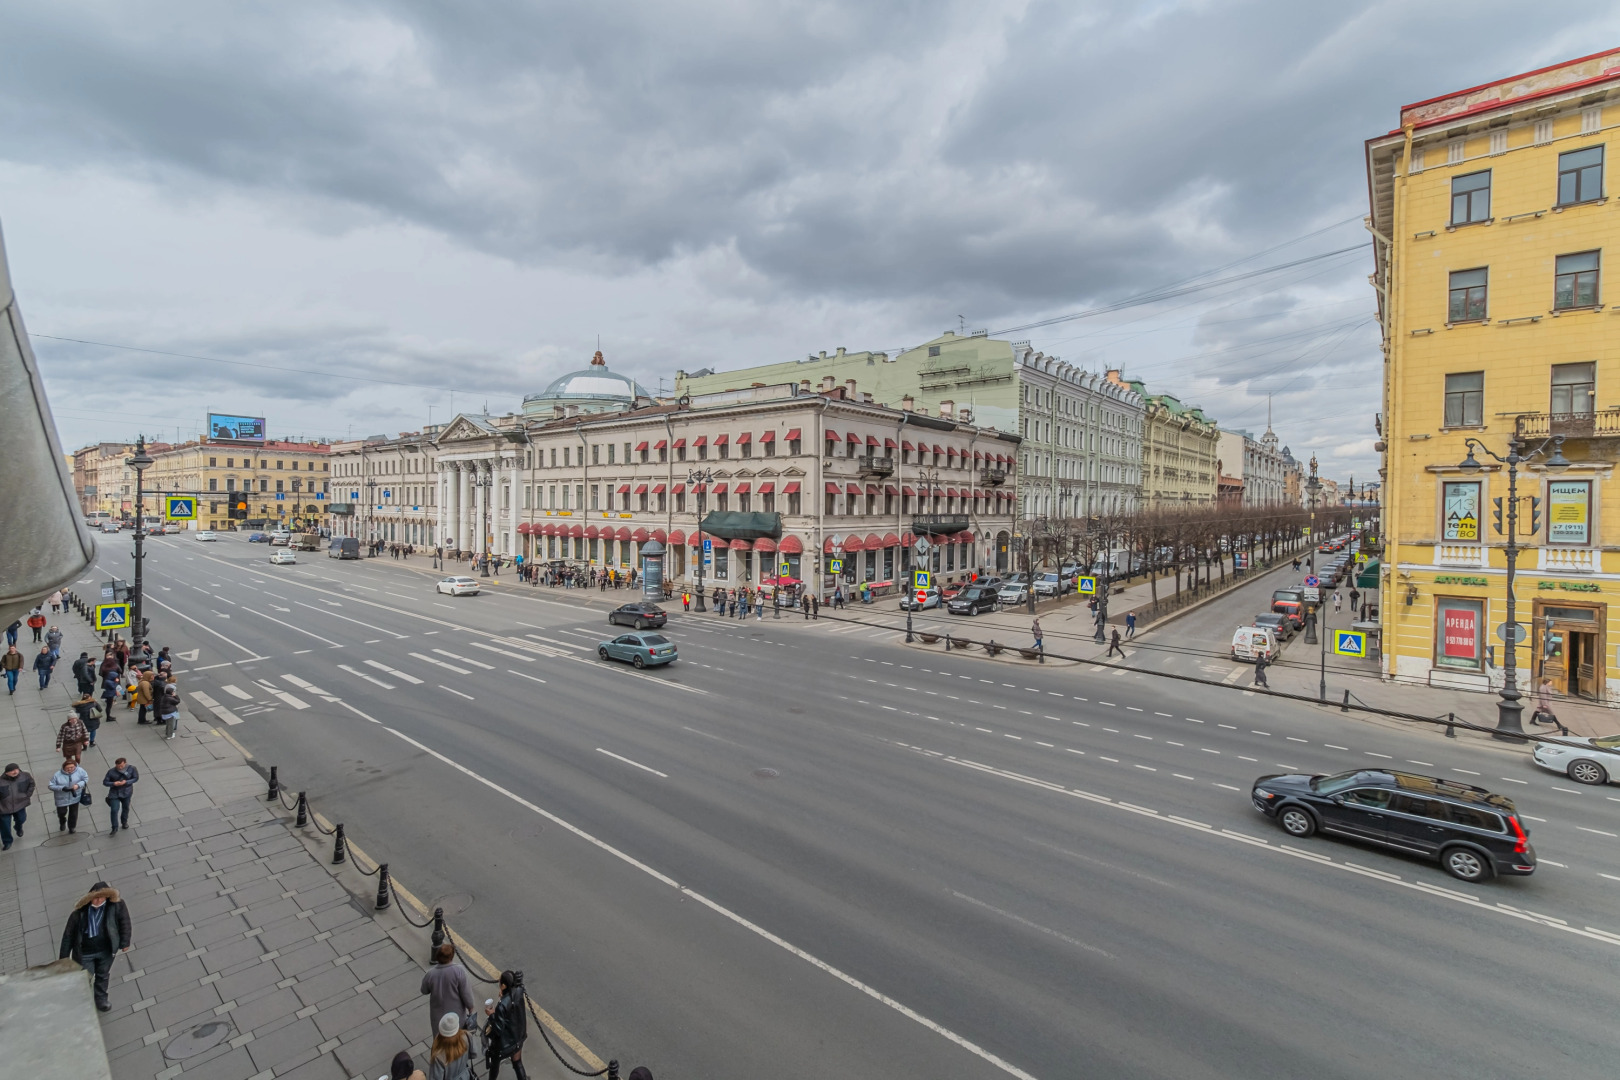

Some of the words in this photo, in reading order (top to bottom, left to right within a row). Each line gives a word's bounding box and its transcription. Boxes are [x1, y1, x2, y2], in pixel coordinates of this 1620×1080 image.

[1449, 499, 1475, 510] ИЗ
[1448, 511, 1475, 521] ДА
[1434, 576, 1488, 586] АПТЕКА
[1537, 581, 1555, 589] 24
[1446, 618, 1474, 630] АРЕНДА
